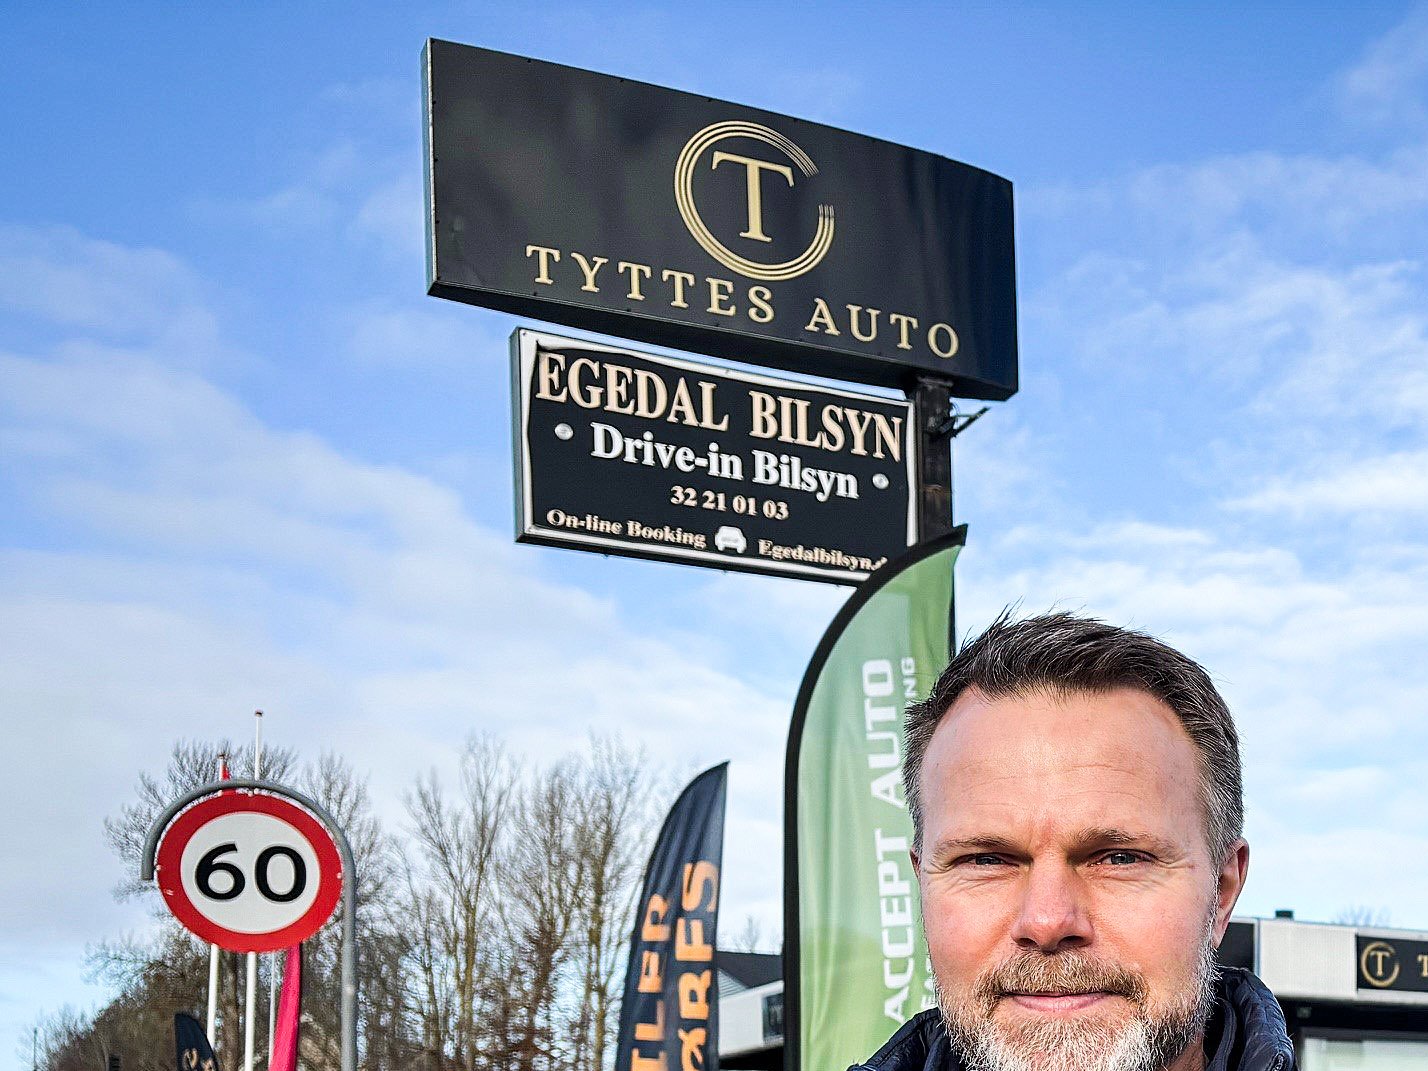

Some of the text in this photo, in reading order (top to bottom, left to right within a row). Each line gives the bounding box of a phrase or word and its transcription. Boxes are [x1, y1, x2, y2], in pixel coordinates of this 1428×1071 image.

[525, 245, 960, 359] TYTTES AUTO
[536, 352, 903, 463] EGEDAL BILSYN
[590, 422, 859, 502] Drive-in Bilsyn
[546, 508, 622, 536] On-line
[625, 519, 707, 550] Booking
[669, 485, 789, 521] 32 21 01 03
[195, 842, 307, 903] 60
[862, 659, 914, 1024] ACCEPT AUTO
